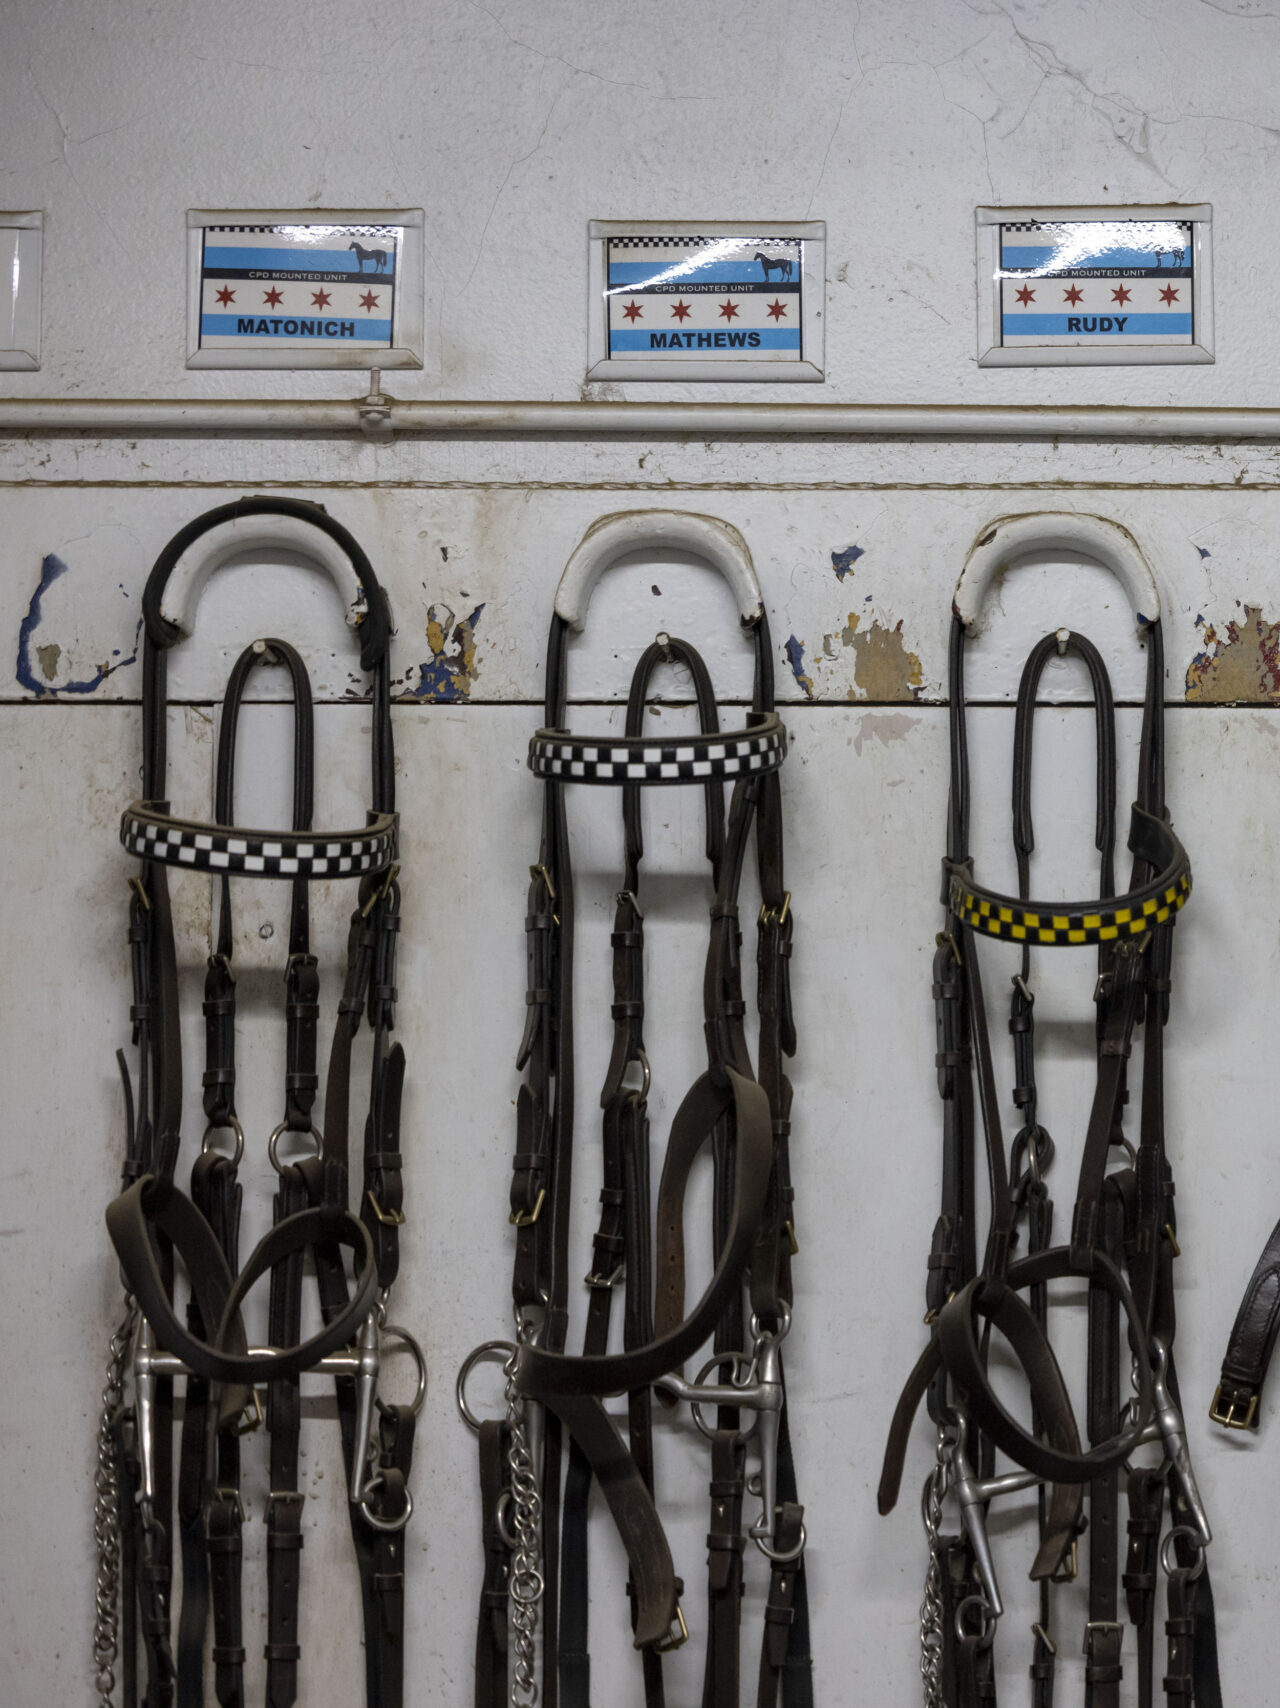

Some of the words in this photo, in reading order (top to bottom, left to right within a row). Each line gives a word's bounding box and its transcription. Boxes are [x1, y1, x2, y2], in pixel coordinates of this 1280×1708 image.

[249, 271, 270, 279] CPD
[272, 272, 322, 281] MOUNTED
[324, 273, 348, 281] UNIT
[1047, 269, 1069, 277] CPD
[1071, 269, 1121, 277] MOUNTED
[1123, 269, 1147, 277] UNIT
[730, 284, 755, 292] UNIT
[237, 318, 355, 337] MATONICH
[1067, 317, 1128, 332] RUDY
[650, 332, 761, 348] MATHEWS
